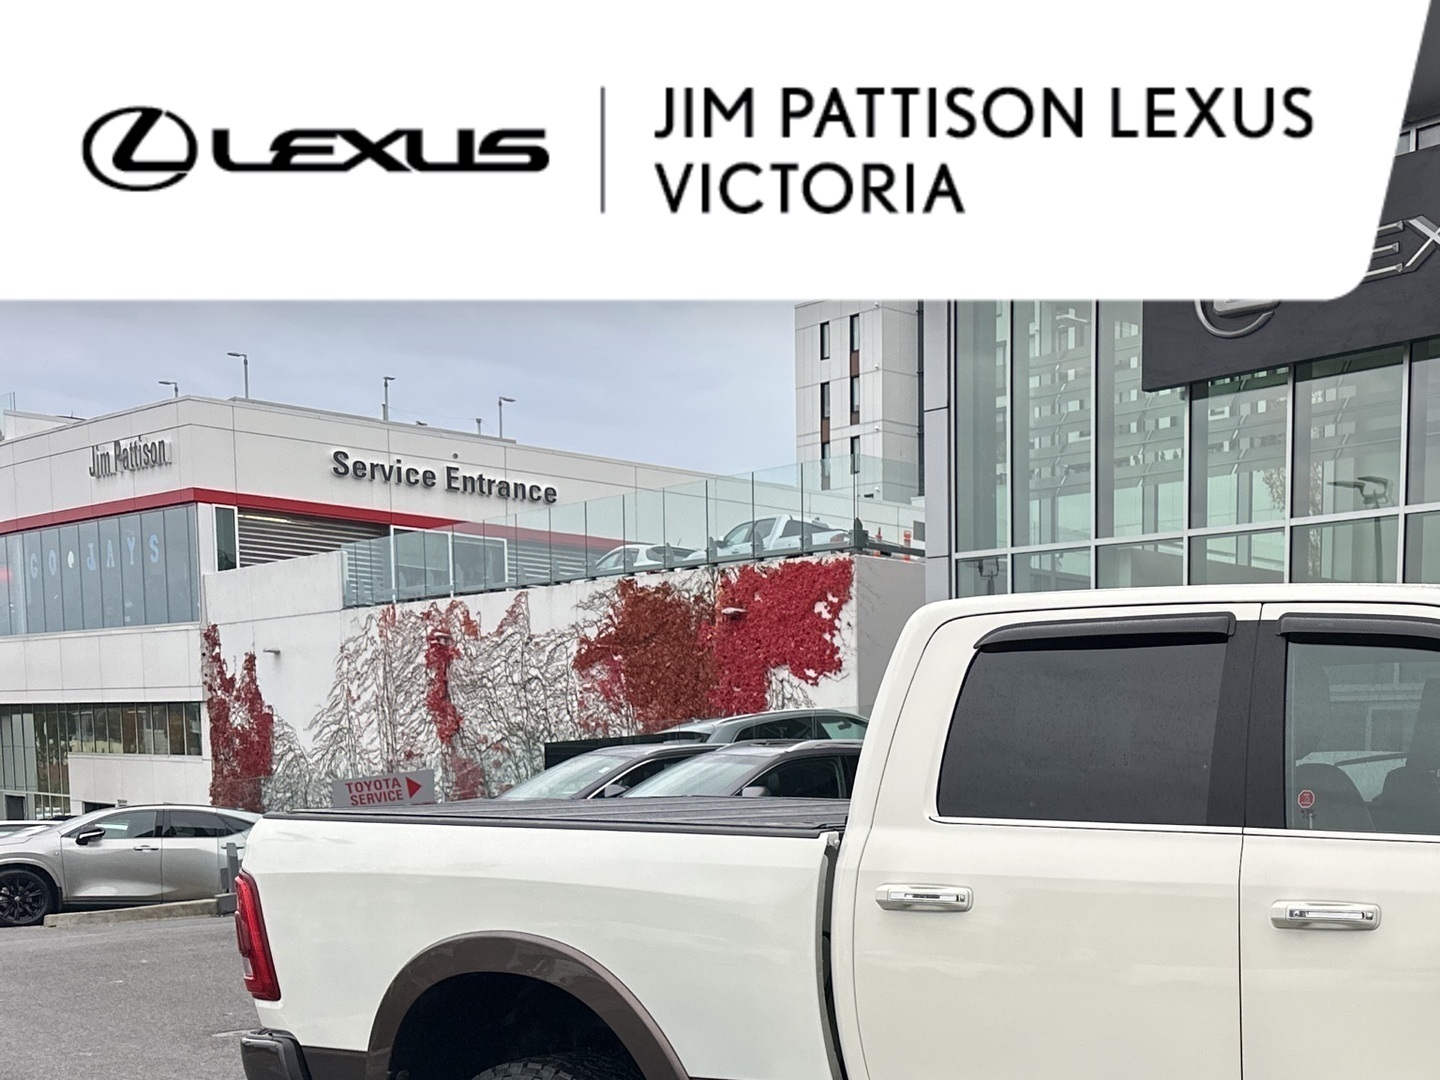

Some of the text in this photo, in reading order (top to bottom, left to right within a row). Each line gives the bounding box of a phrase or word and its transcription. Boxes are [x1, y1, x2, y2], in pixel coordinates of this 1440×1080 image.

[89, 435, 170, 478] Jim Pattison
[332, 449, 558, 505] Service Entrance
[30, 549, 57, 580] GO
[345, 777, 402, 794] TOYOTA
[350, 789, 405, 806] SERVICE
